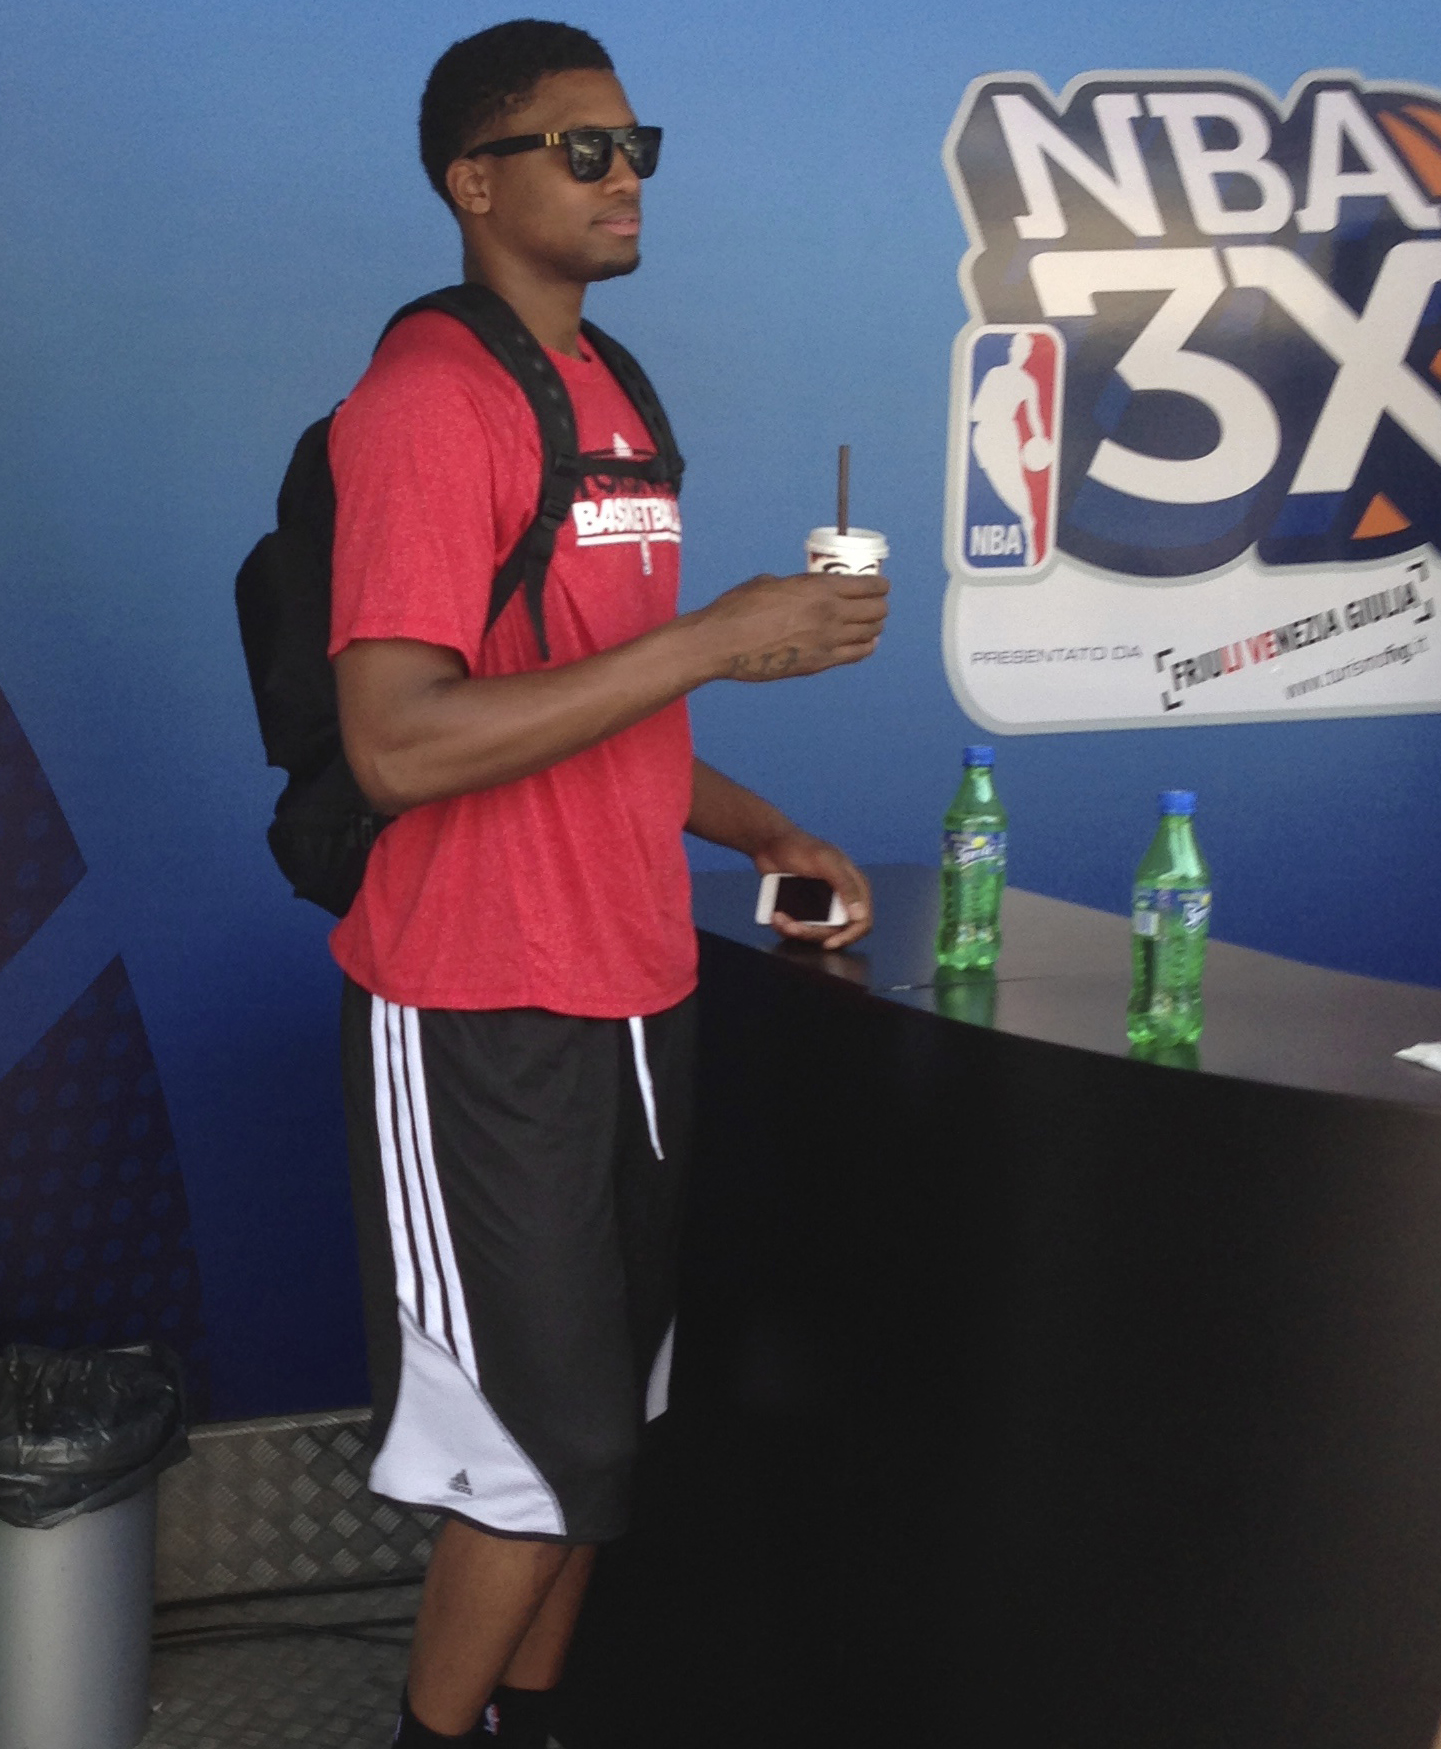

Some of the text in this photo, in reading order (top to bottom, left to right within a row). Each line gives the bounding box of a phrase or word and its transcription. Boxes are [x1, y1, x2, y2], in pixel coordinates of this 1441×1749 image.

[991, 92, 1441, 239] NBA
[970, 524, 1022, 556] NBA
[970, 645, 1143, 665] PRESENTATO DA
[1170, 580, 1421, 692] FRIULI VENEZIA GIULIA
